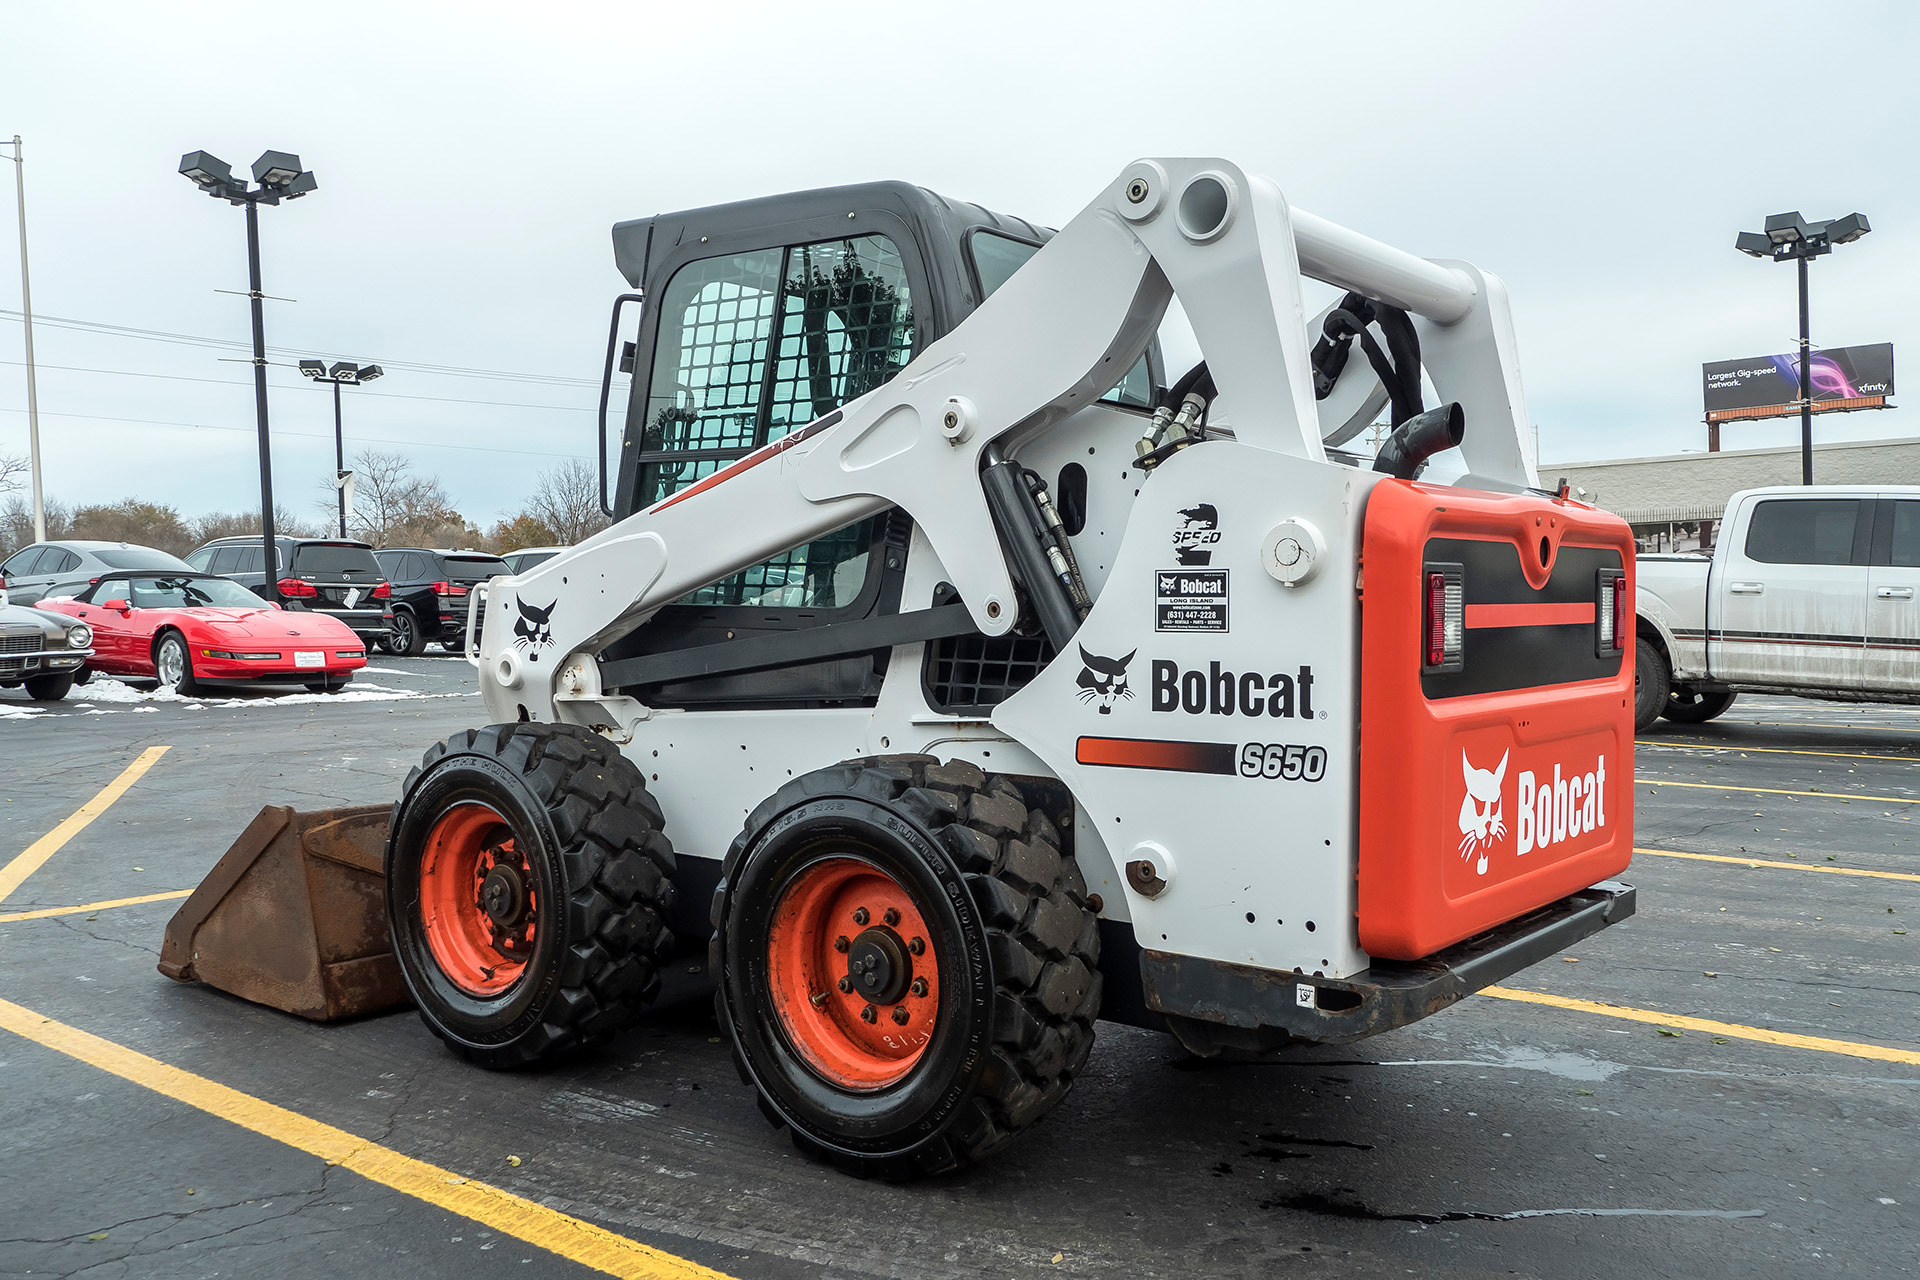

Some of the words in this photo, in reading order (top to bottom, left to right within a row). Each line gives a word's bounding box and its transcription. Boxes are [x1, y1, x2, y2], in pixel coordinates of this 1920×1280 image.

[1707, 371, 1736, 381] Largest
[1737, 366, 1777, 378] Gig-speed
[1708, 379, 1741, 389] network.
[1858, 382, 1888, 393] xfinity
[1171, 531, 1222, 544] SPEED
[1180, 578, 1222, 594] Bobcat
[1167, 611, 1184, 620] (631)
[1151, 659, 1315, 720] Bobcat
[1239, 742, 1328, 783] S650
[1516, 754, 1606, 857] Bobcat
[885, 816, 948, 876] SUPER
